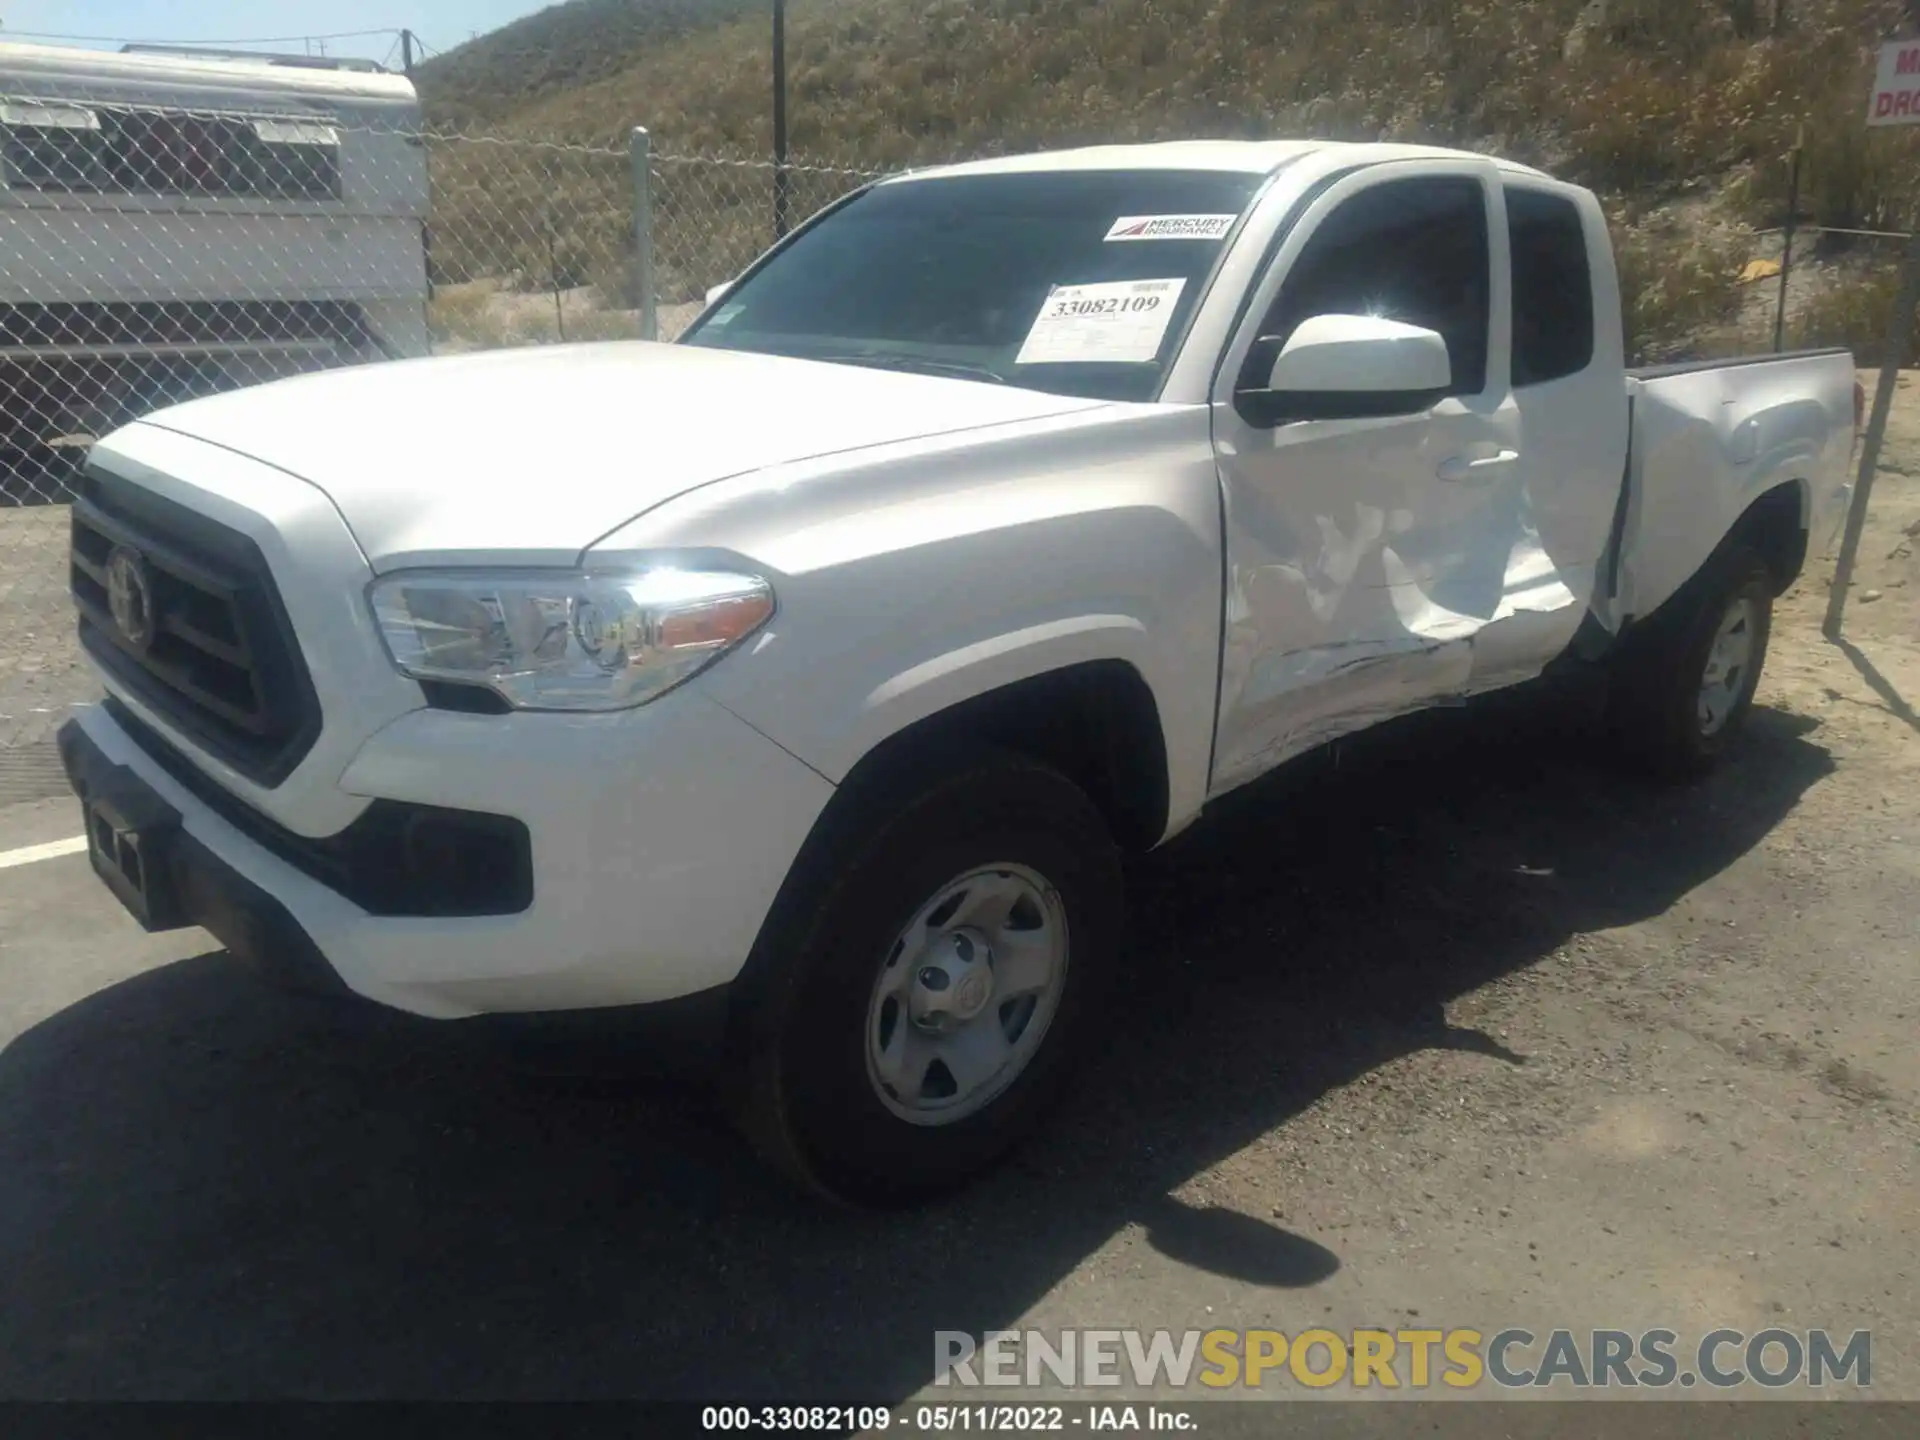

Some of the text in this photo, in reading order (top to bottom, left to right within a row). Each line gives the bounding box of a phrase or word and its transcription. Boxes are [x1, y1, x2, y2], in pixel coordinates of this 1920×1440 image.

[1895, 48, 1920, 75] M
[1144, 226, 1223, 236] INSURANCE
[1149, 218, 1229, 228] MERCURY
[1051, 295, 1161, 318] 33082109
